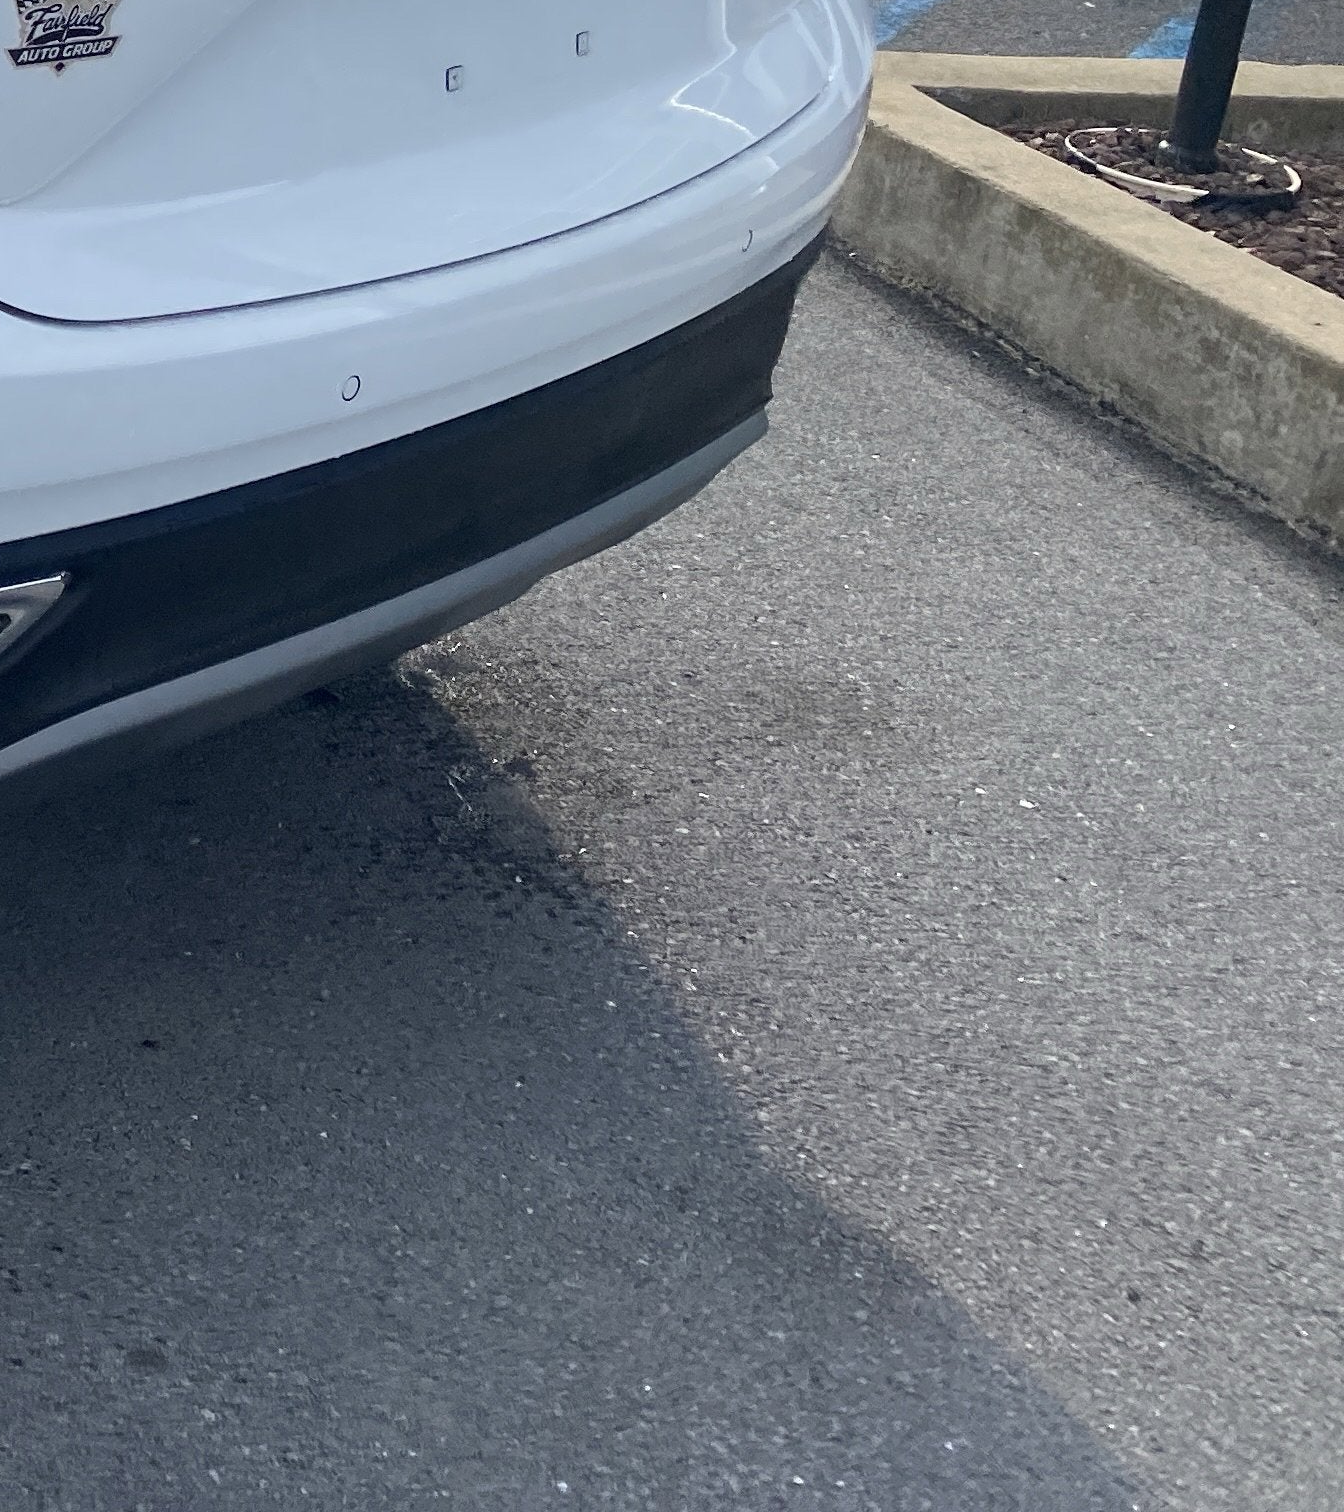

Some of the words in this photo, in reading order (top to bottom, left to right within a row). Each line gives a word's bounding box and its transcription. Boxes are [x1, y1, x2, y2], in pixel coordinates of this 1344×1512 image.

[24, 3, 113, 46] Fairfield
[17, 47, 60, 63] AUTO
[62, 39, 113, 58] GROUP
